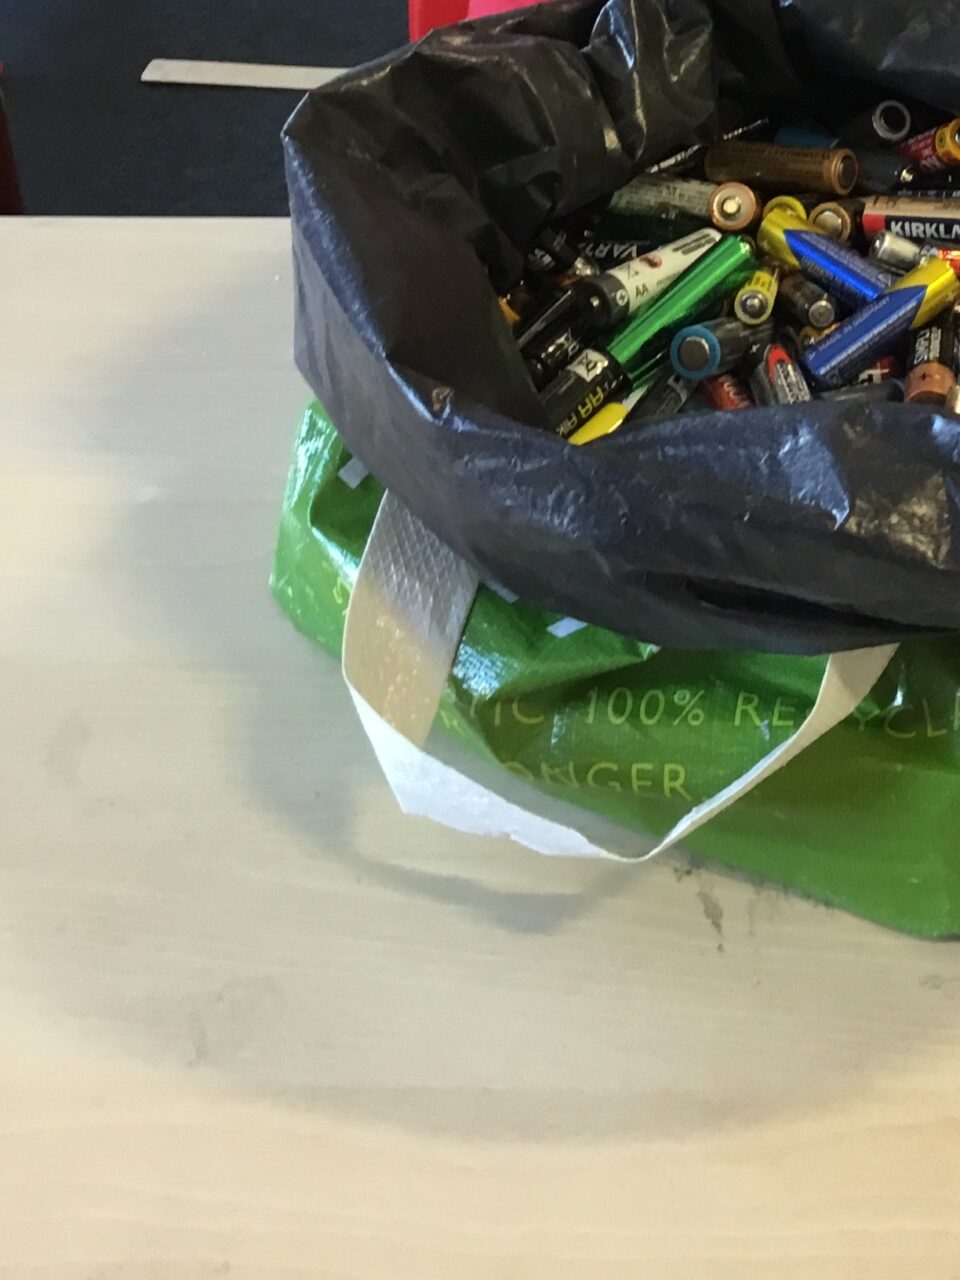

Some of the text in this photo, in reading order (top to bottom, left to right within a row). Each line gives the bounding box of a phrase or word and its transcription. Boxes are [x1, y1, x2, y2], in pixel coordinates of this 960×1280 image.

[635, 285, 650, 300] AA
[578, 385, 606, 418] AA
[584, 686, 706, 727] 100%
